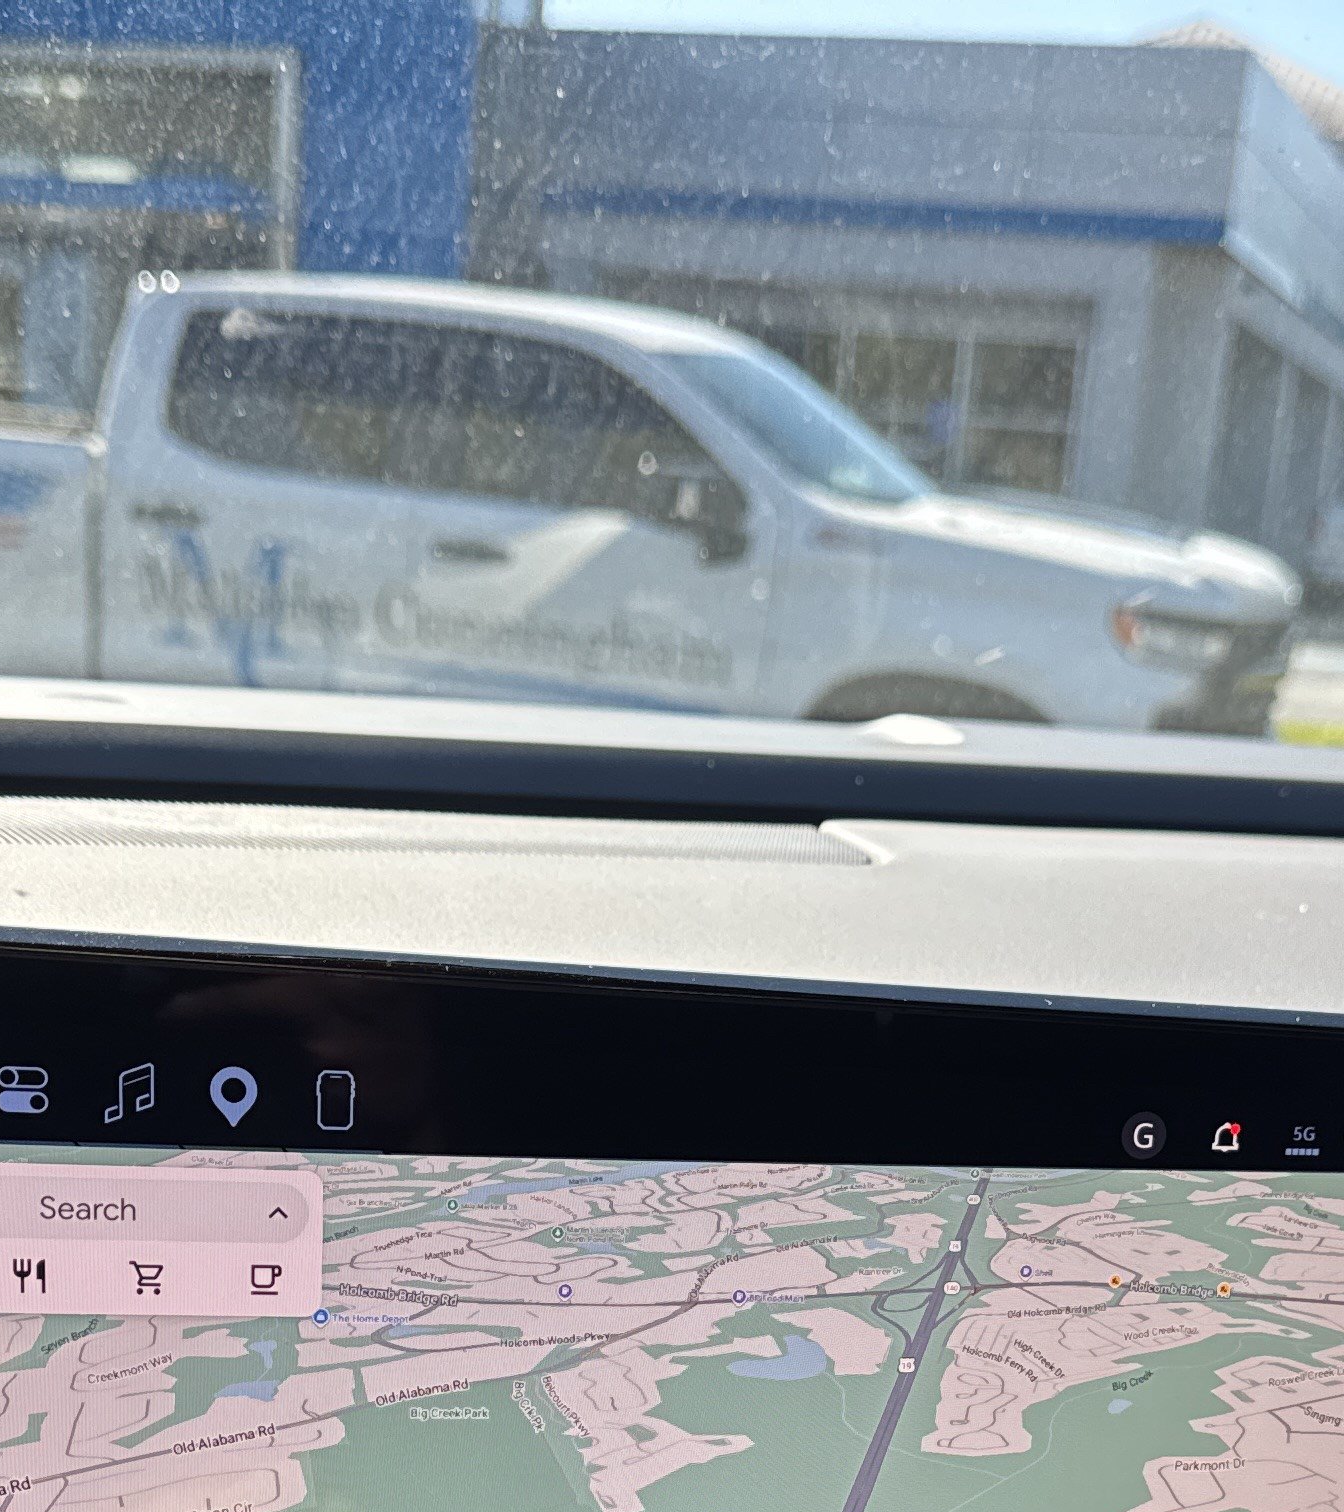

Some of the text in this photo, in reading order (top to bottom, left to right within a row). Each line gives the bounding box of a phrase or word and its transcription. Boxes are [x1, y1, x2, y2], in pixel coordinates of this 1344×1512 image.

[1133, 1123, 1154, 1148] G
[1293, 1126, 1316, 1142] 5G
[40, 1196, 137, 1222] Search
[453, 1247, 465, 1257] Rd
[406, 1267, 429, 1280] Pond
[339, 1283, 459, 1307] Holcomb Bridge Rd
[1130, 1281, 1178, 1295] Holcomb
[1180, 1285, 1214, 1299] Bridge
[332, 1313, 410, 1326] The Home Depot
[1023, 1307, 1063, 1318] Holcomb
[1094, 1303, 1107, 1312] Rd
[499, 1332, 611, 1348] Holcomb Woods Pkwy
[1124, 1329, 1150, 1341] Wood
[1152, 1326, 1176, 1337] Creek
[40, 1335, 71, 1354] Seven
[87, 1352, 174, 1385] Creekmont Way
[901, 1361, 913, 1371] 19
[962, 1344, 1039, 1383] Holcomb Ferry Rd
[1013, 1338, 1066, 1380] High Creek Dr
[1112, 1369, 1154, 1392] Big Creek
[1268, 1374, 1307, 1387] Roswell
[1308, 1368, 1335, 1381] Creek
[375, 1379, 469, 1408] Old Alabama Rd
[410, 1408, 489, 1421] Big Creek Park
[511, 1381, 544, 1433] Big Crk Pk
[1303, 1405, 1342, 1427] Singing
[567, 1412, 591, 1438] Pkwy
[172, 1423, 276, 1456] Old Alabama Rd
[1174, 1457, 1247, 1472] Parkmont Dr
[10, 1476, 33, 1492] Rd
